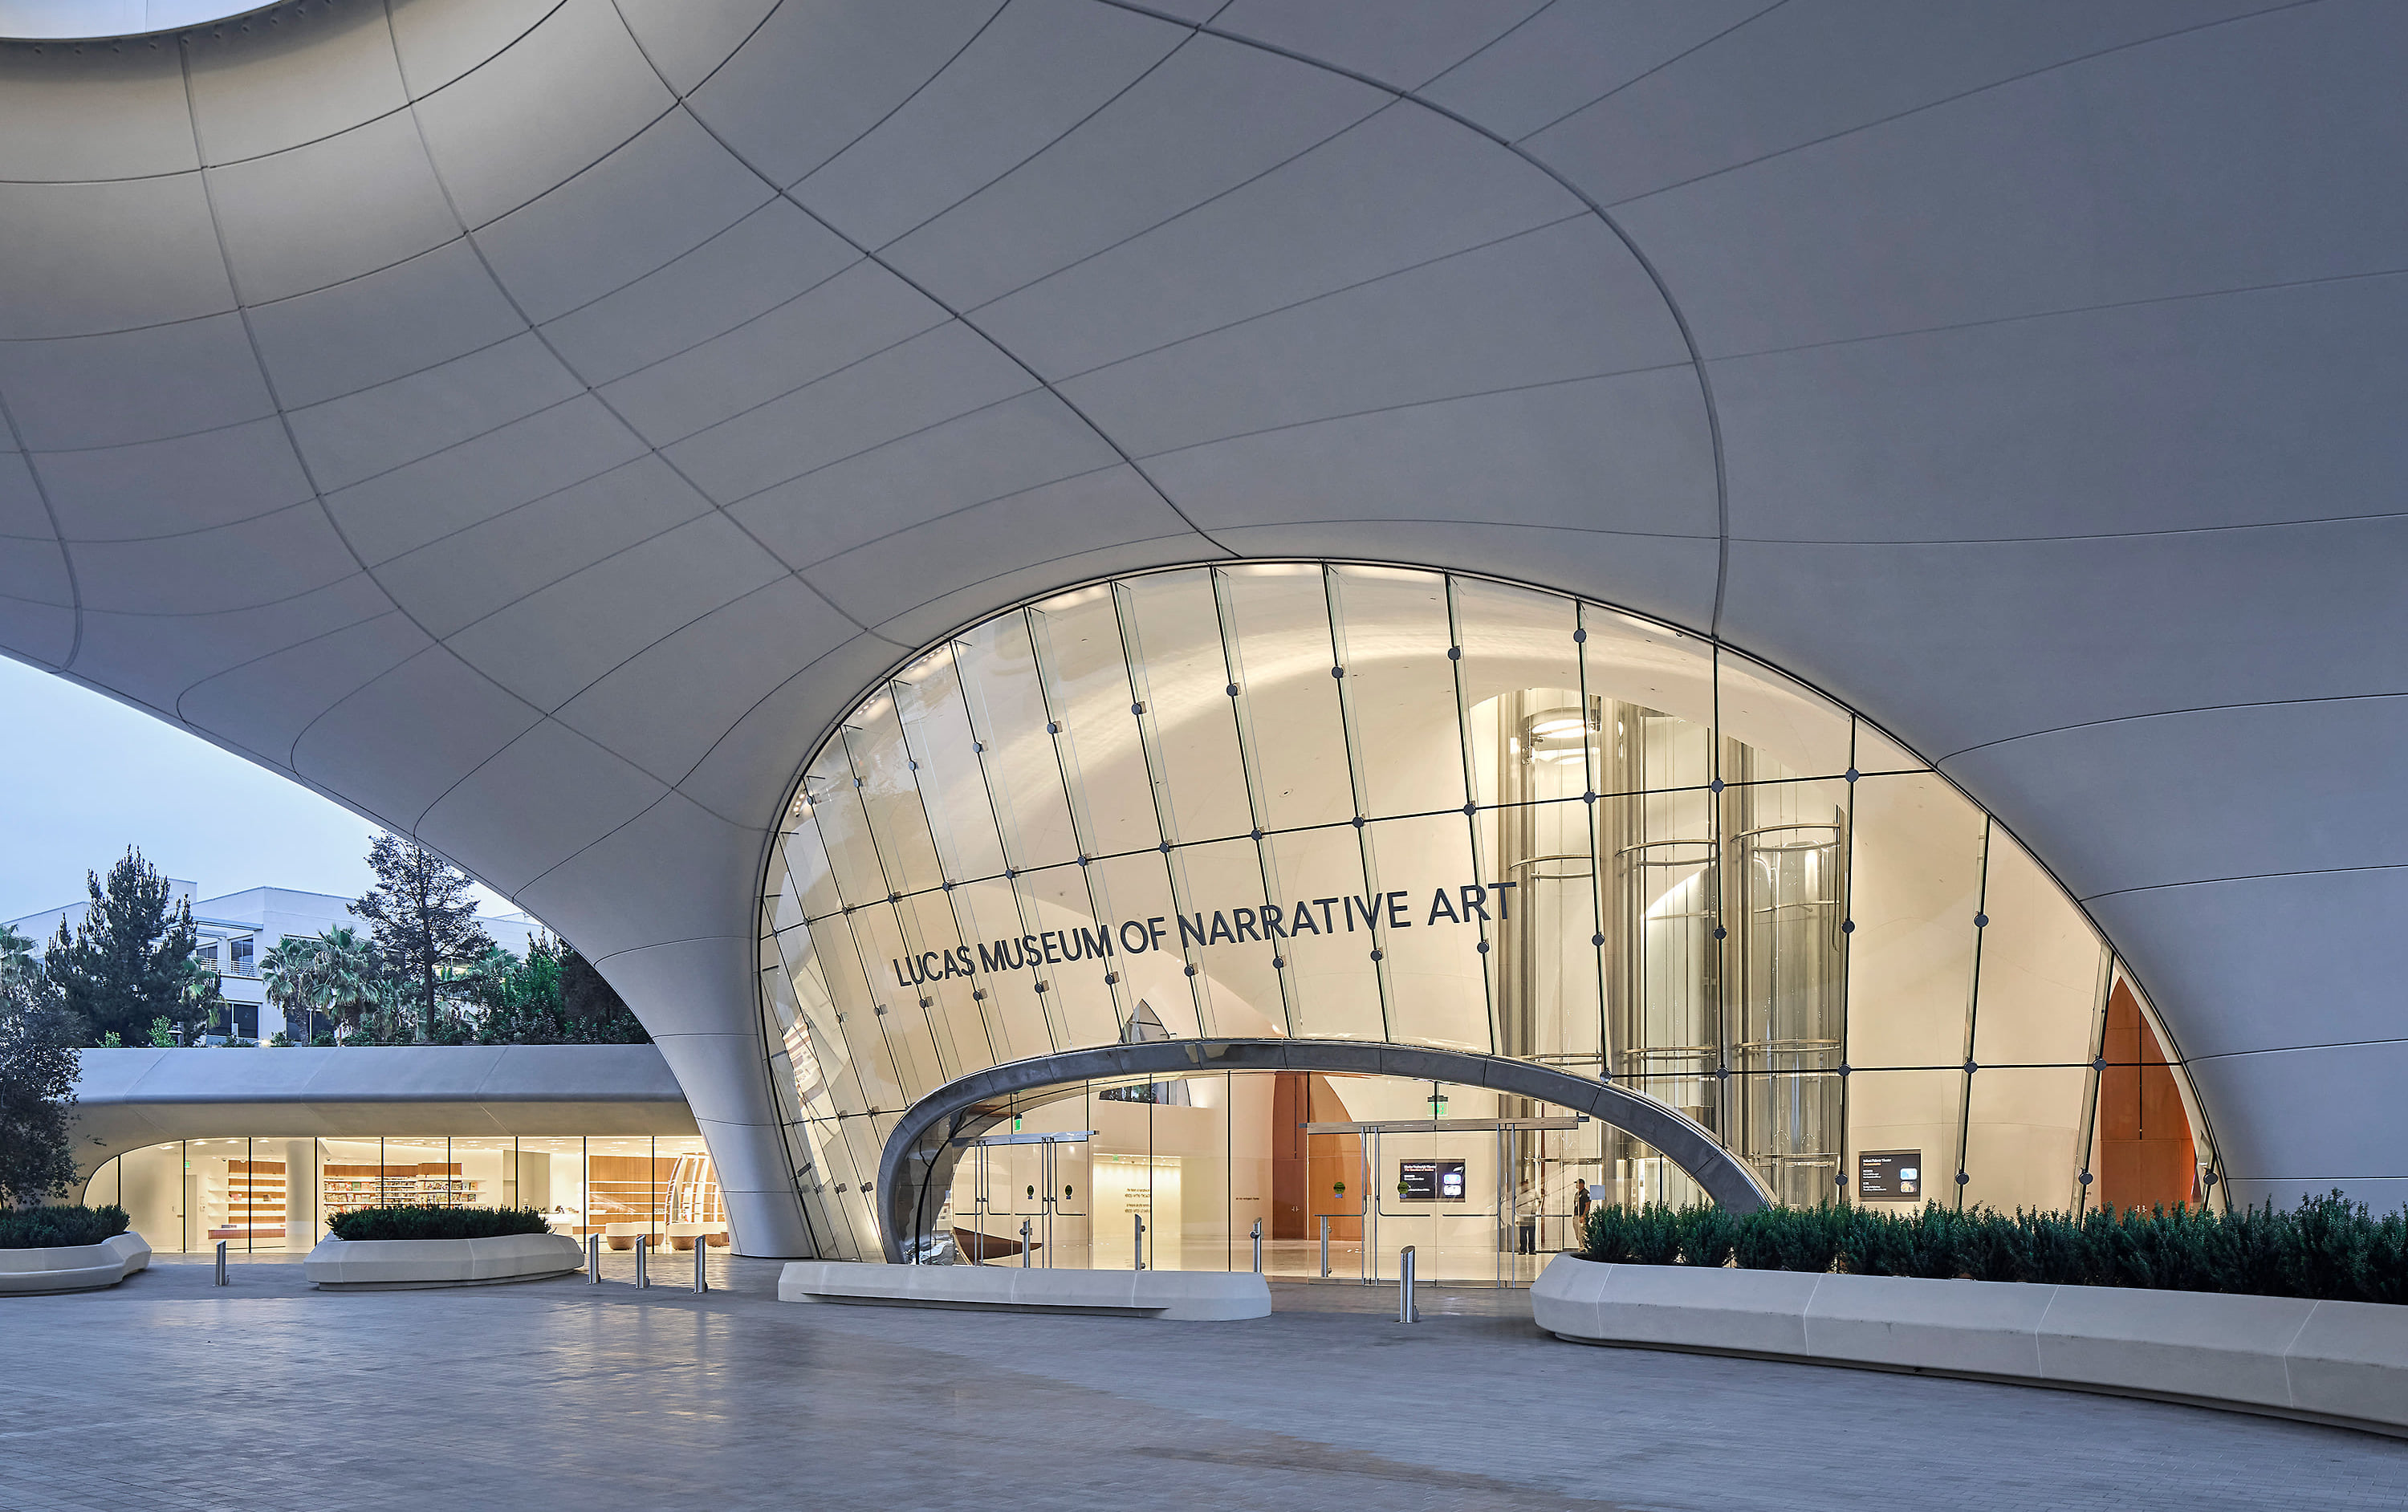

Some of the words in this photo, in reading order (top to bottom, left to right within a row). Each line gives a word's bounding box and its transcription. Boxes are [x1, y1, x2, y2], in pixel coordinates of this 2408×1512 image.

[893, 945, 975, 986] LUCAS
[978, 925, 1114, 973] MUSEUM
[1120, 917, 1166, 953] OF
[1178, 891, 1411, 948] NARRATIVE
[1428, 881, 1516, 925] ART
